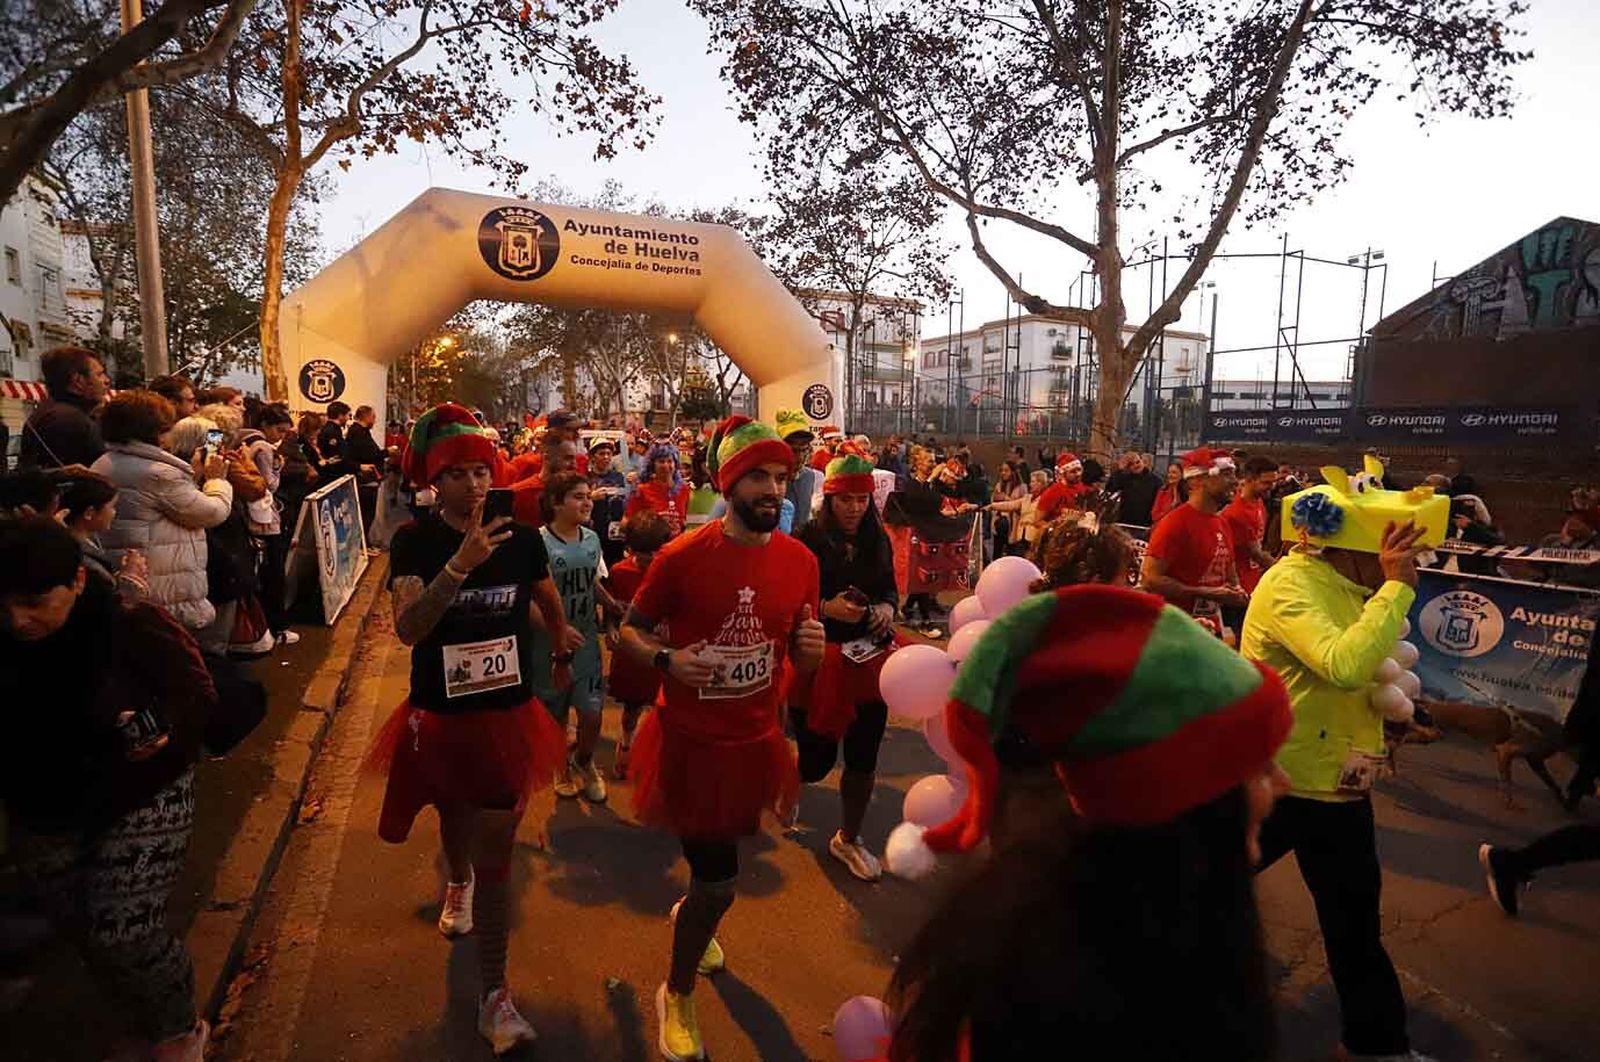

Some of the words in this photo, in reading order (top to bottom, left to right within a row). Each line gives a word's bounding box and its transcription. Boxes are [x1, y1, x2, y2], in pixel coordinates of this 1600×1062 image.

[563, 219, 699, 245] Ayuntamiento
[605, 239, 628, 255] de
[634, 242, 700, 262] Huelva
[634, 261, 649, 271] de
[651, 263, 702, 276] Deportes
[1228, 417, 1268, 426] HYUNDAI
[1296, 417, 1342, 426] HYUNDAI
[1389, 415, 1446, 426] HYUNDAI
[1488, 413, 1558, 426] HYUNDAI
[482, 653, 506, 677] 20
[731, 657, 767, 684] 403
